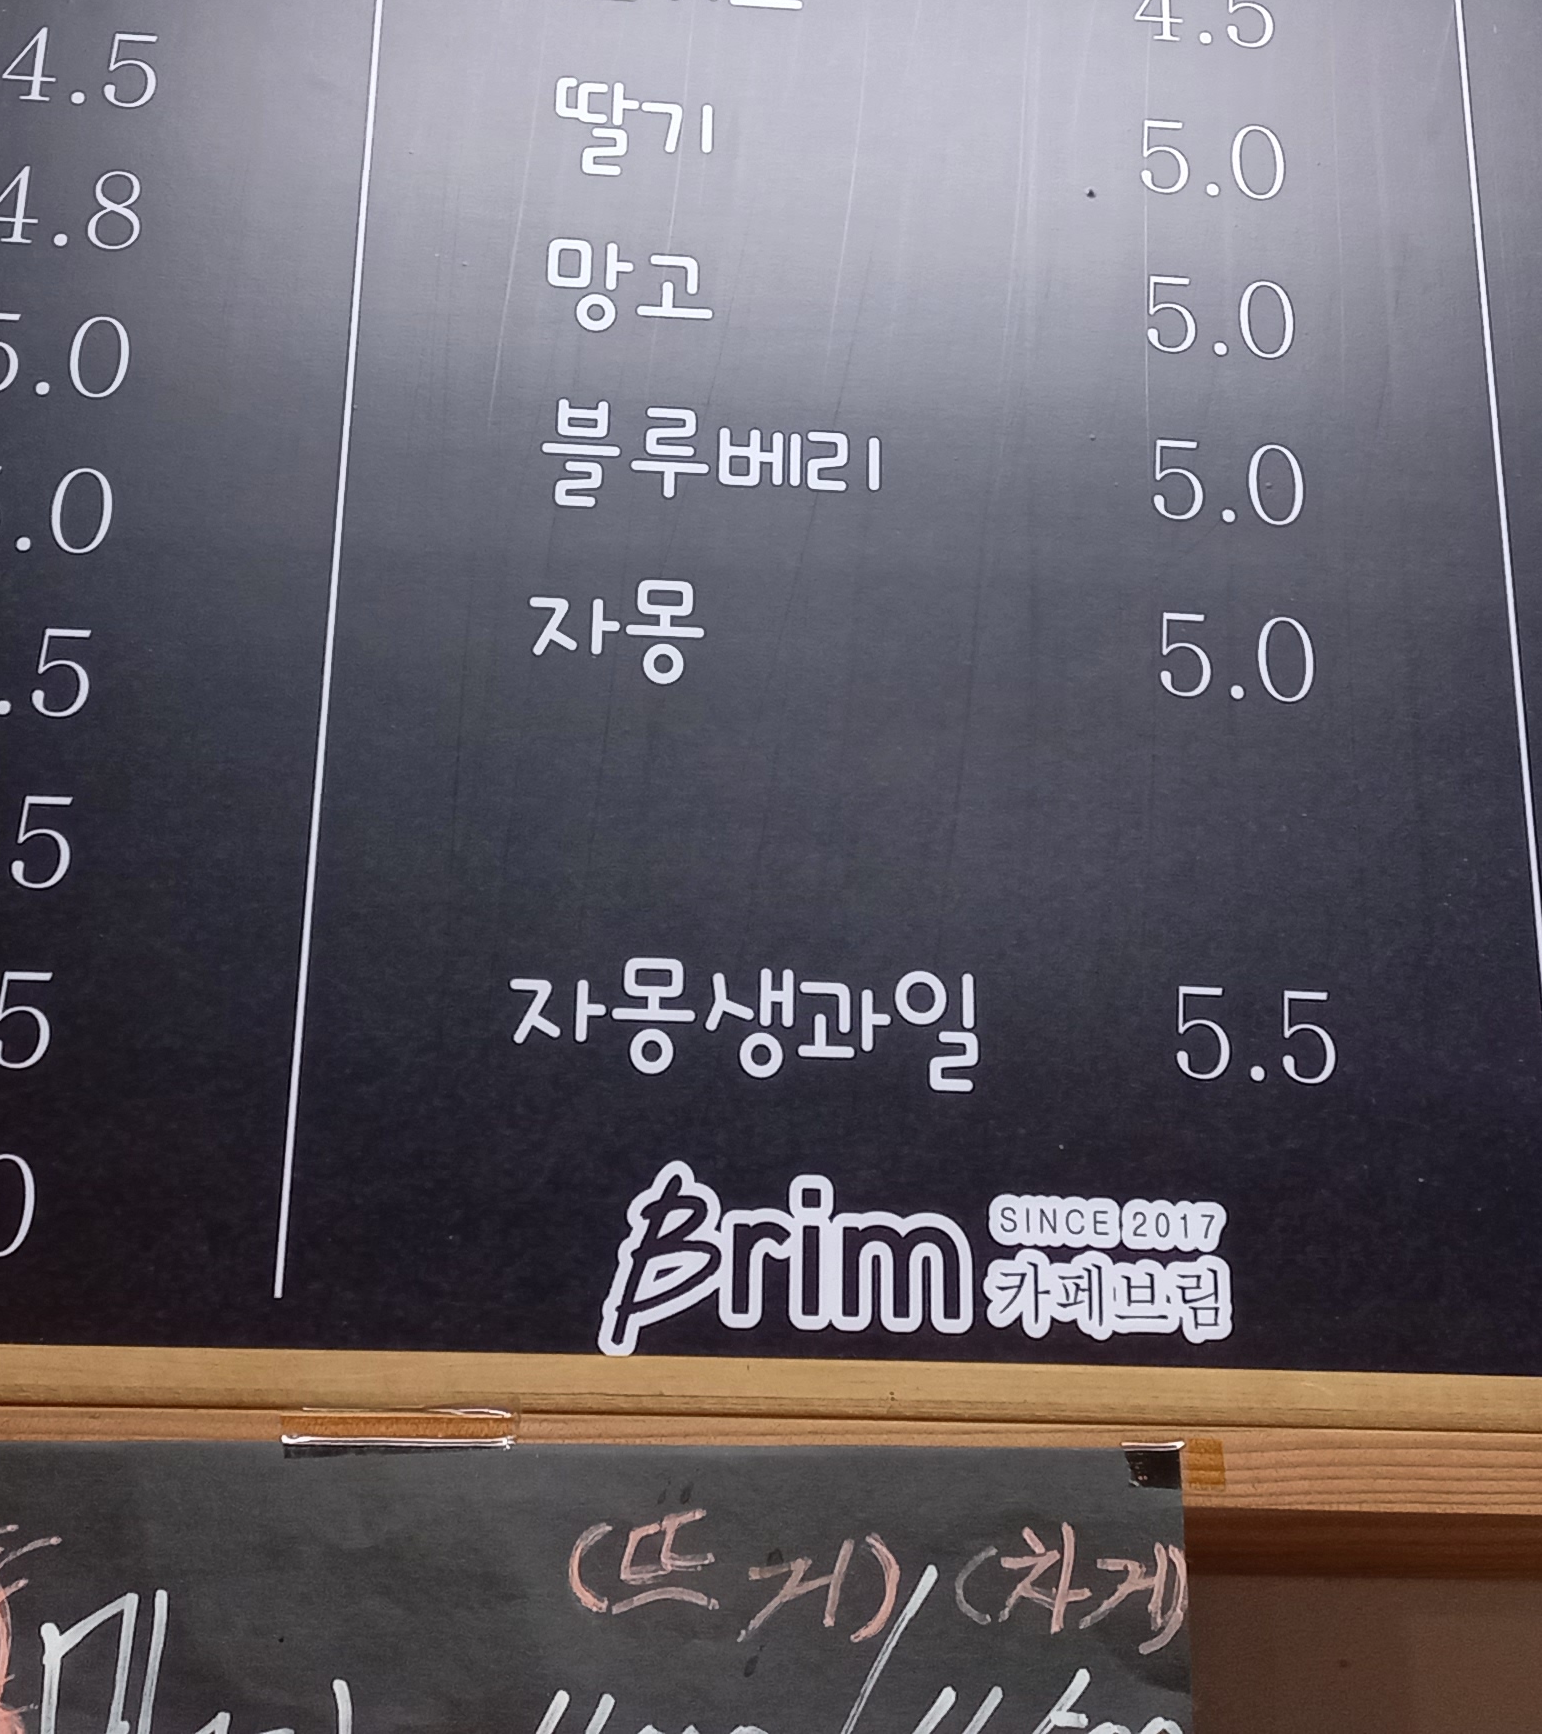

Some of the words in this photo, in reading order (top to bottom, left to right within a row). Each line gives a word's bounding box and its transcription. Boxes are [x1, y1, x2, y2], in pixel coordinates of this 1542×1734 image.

[1, 25, 159, 109] 4.5
[554, 76, 714, 177] 딸기
[1140, 118, 1285, 201] 5.0
[546, 237, 714, 332] 망고
[1146, 274, 1295, 359] 5.0
[540, 397, 881, 509] 블루베리
[1152, 438, 1305, 527] 5.0
[528, 578, 706, 686] 자몽
[1159, 610, 1315, 703] 5.0
[508, 956, 980, 1093] 자몽생과일
[1175, 984, 1337, 1085] 5.5
[605, 1170, 969, 1350] Brim
[997, 1204, 1112, 1238] SINCE
[1129, 1209, 1218, 1242] 2017
[993, 1258, 1223, 1332] 카페브림
